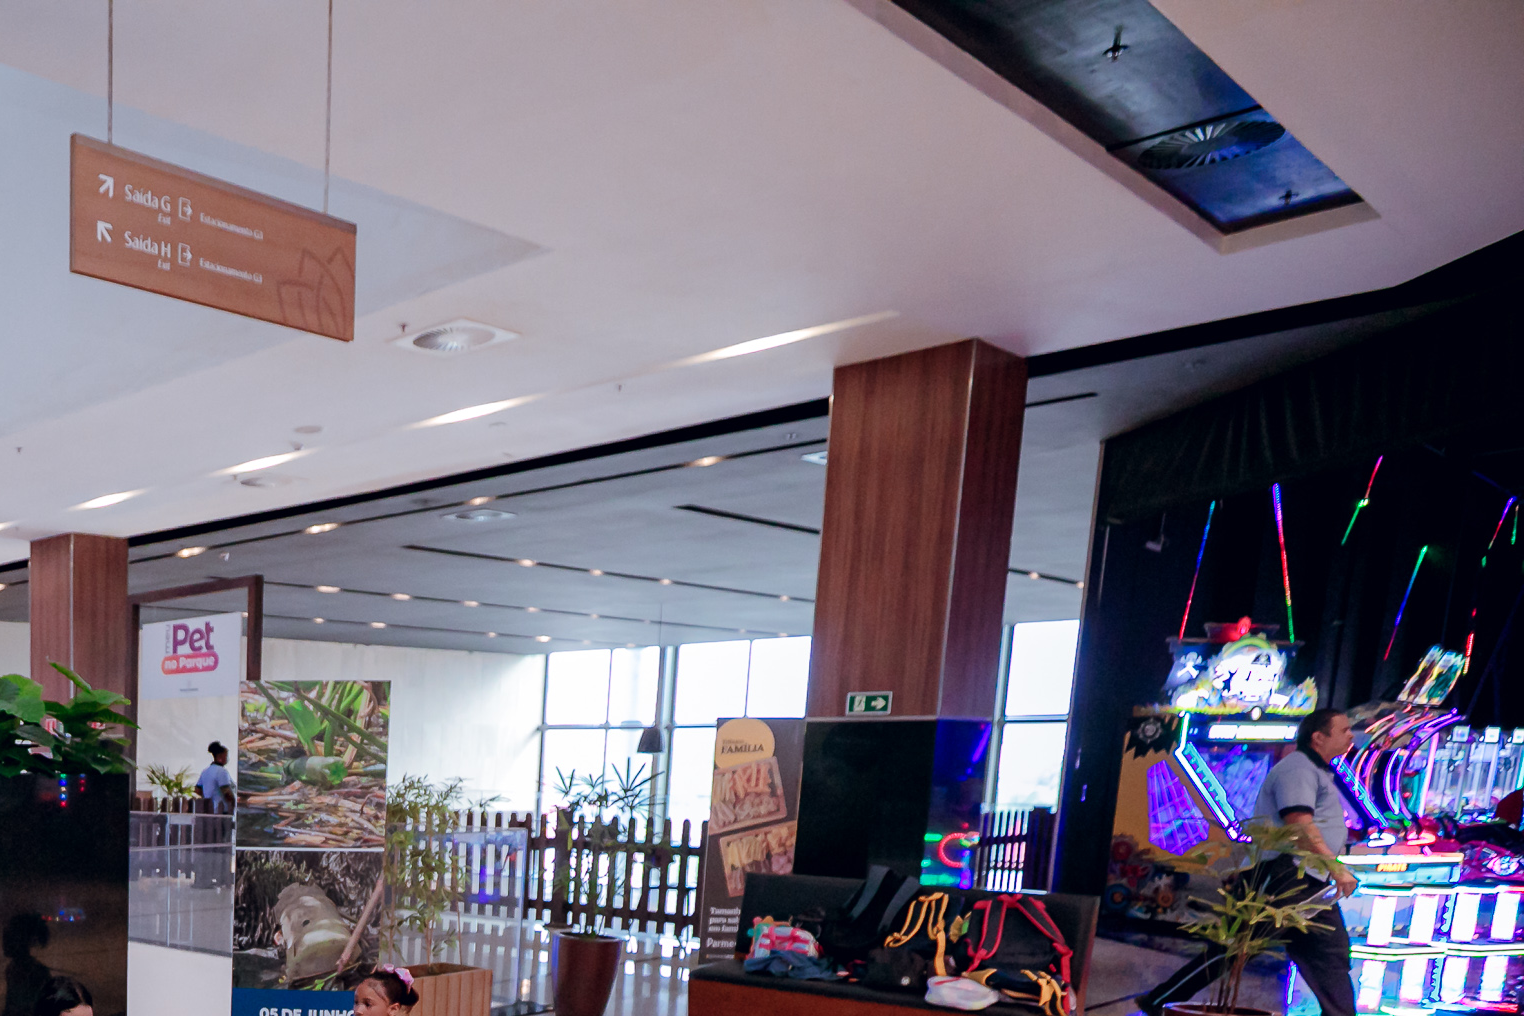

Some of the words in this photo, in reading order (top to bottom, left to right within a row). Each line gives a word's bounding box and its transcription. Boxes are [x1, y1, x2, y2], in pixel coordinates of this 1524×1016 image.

[160, 195, 171, 213] G
[160, 240, 171, 258] H
[172, 620, 215, 655] Pet
[164, 659, 178, 670] no
[179, 656, 215, 669] Parque
[709, 906, 742, 916] Tamanh
[706, 937, 736, 949] Parme
